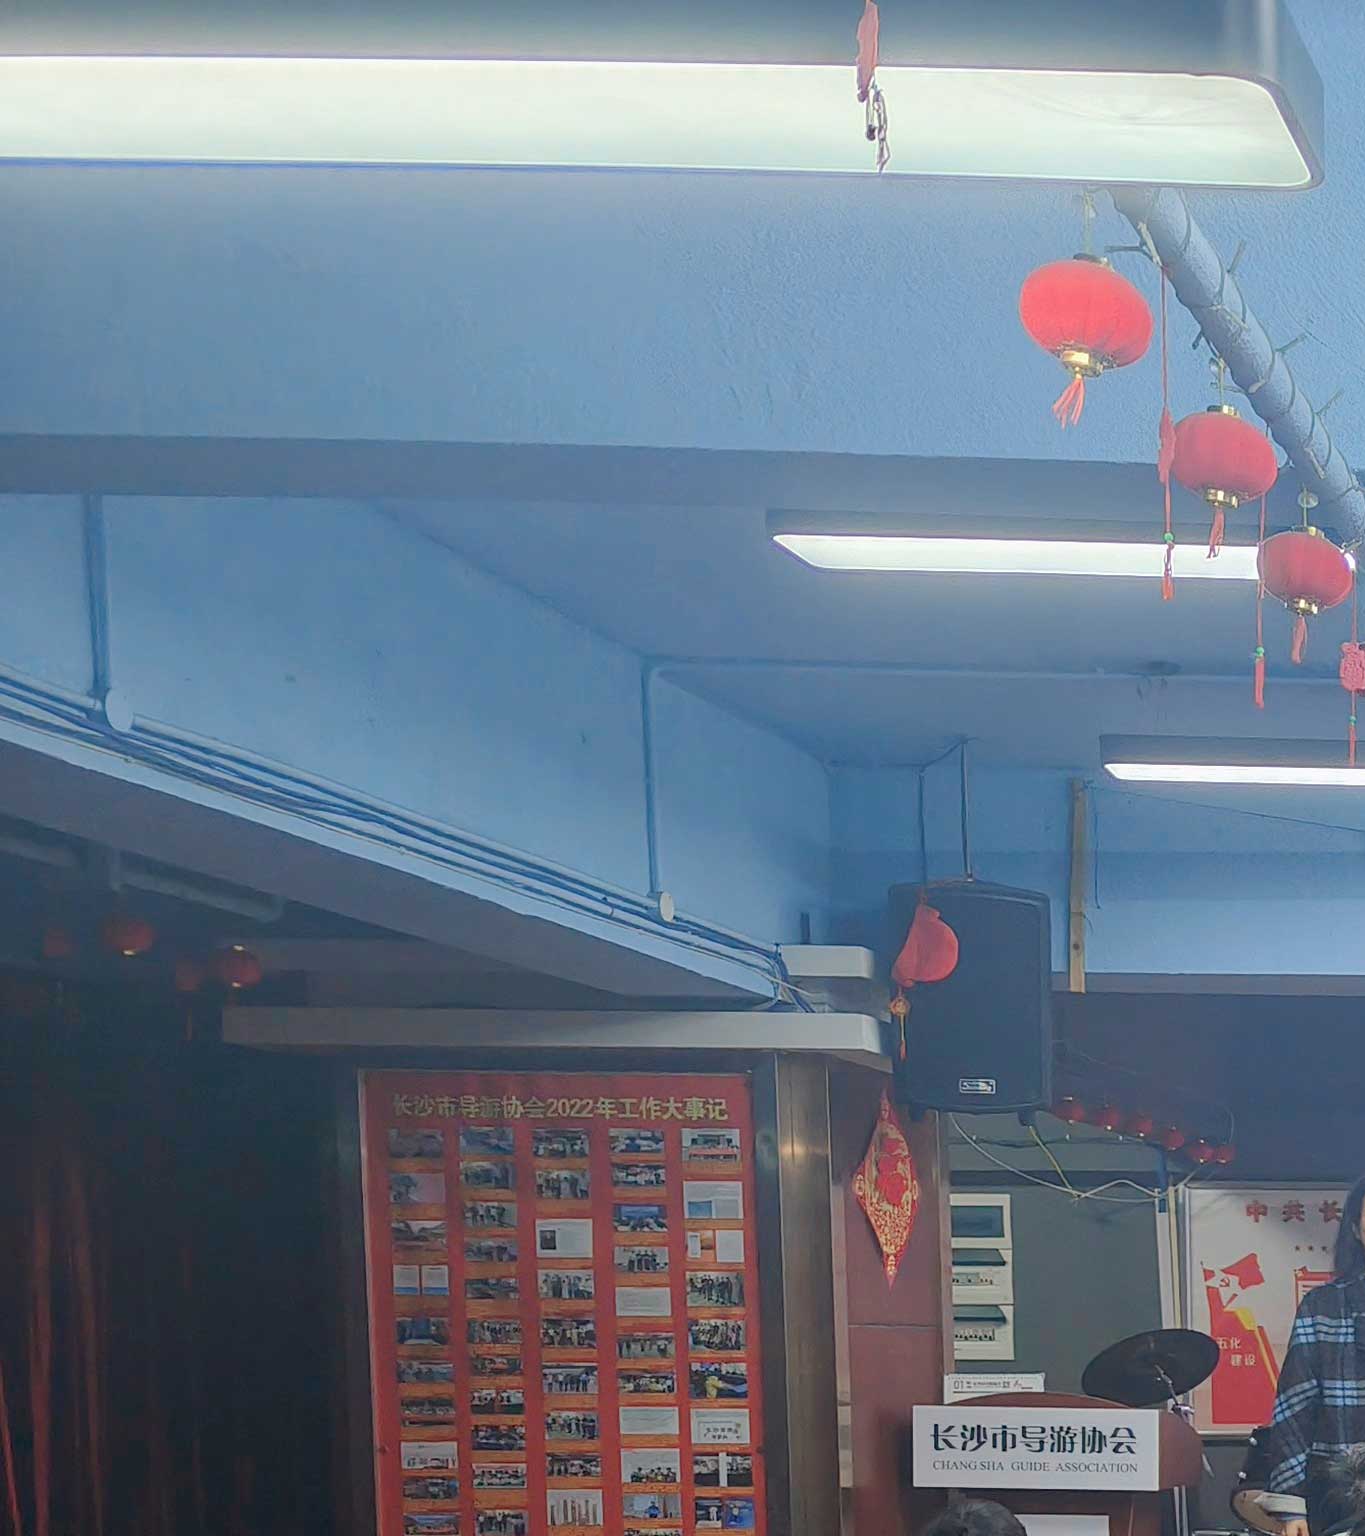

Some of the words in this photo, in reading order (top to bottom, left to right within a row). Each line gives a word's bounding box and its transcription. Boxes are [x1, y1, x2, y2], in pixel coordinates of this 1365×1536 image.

[930, 1424, 1137, 1455] 长沙市导游协会
[1011, 1462, 1050, 1472] GUIDE
[1055, 1463, 1138, 1473] ASSOCIATION
